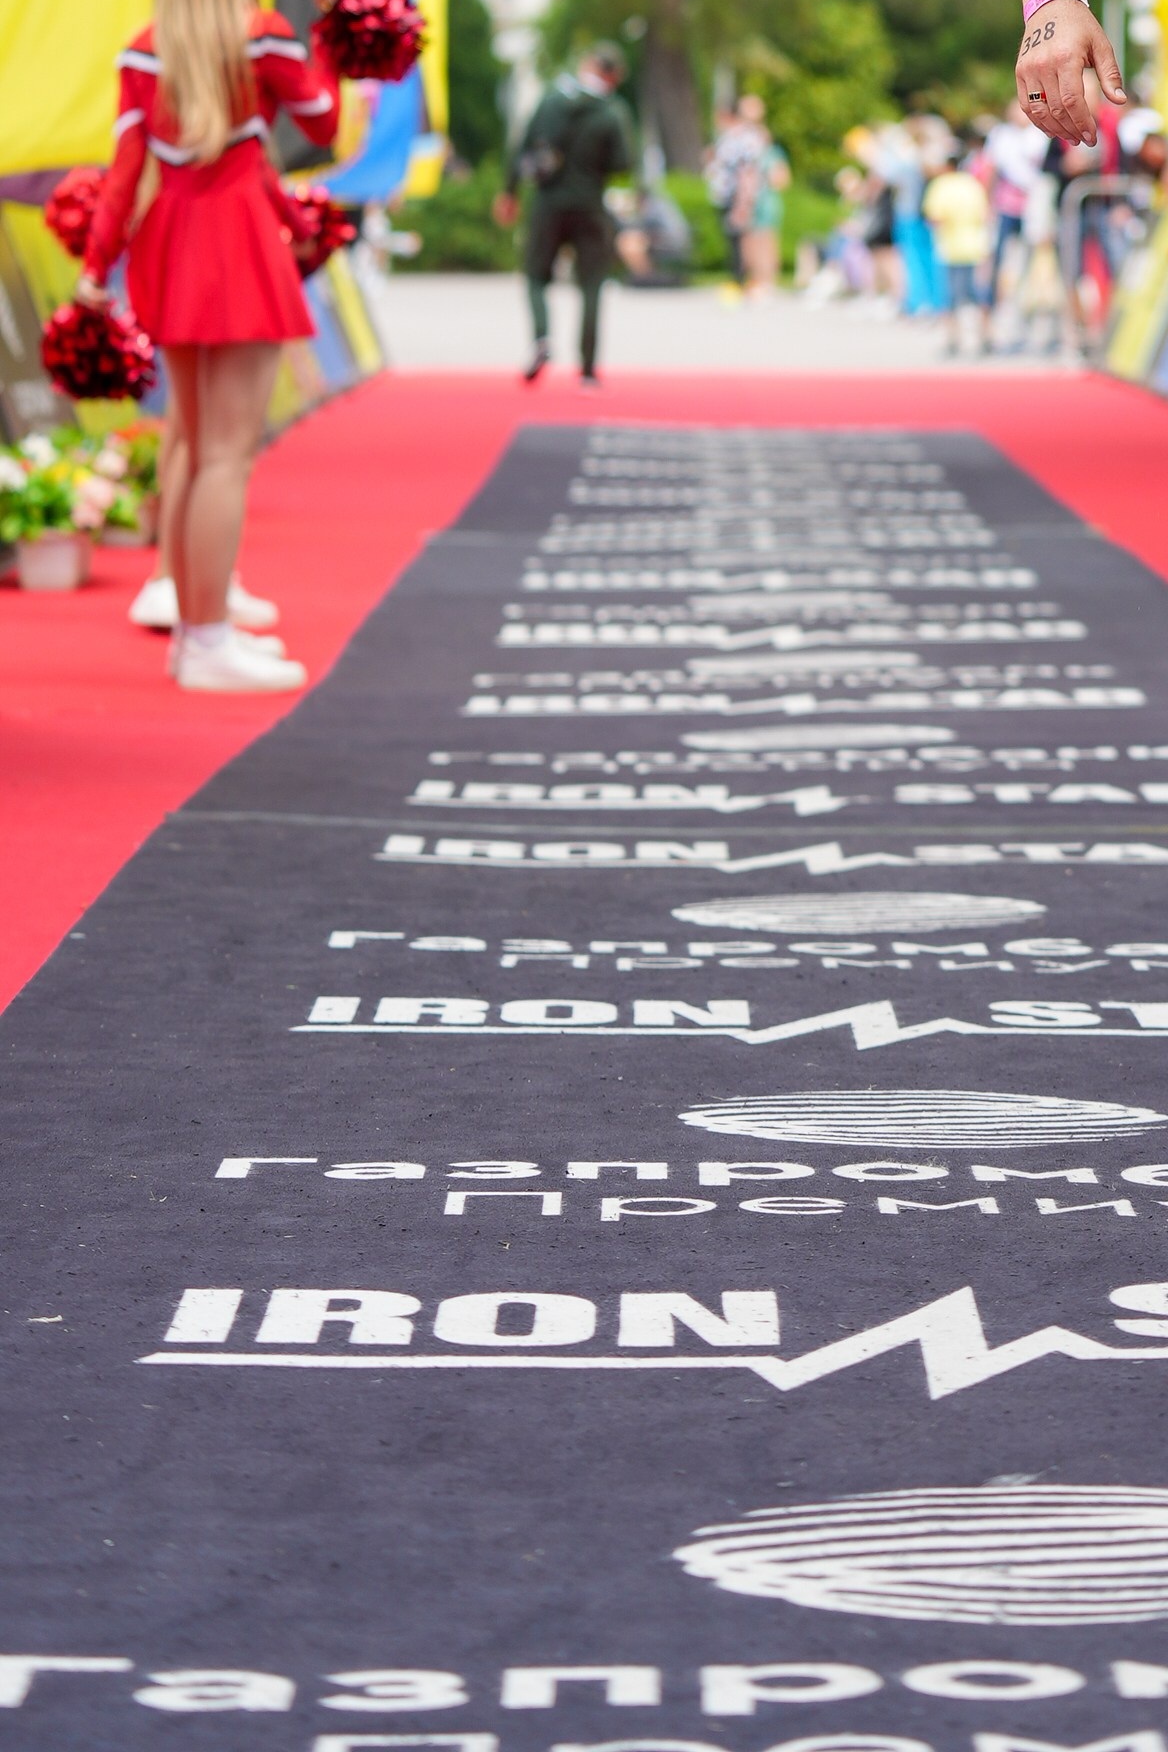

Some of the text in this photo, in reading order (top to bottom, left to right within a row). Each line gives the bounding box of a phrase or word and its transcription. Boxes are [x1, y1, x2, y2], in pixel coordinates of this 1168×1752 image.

[1021, 20, 1056, 57] 328
[307, 996, 751, 1026] IRON
[163, 1287, 782, 1348] IRON
